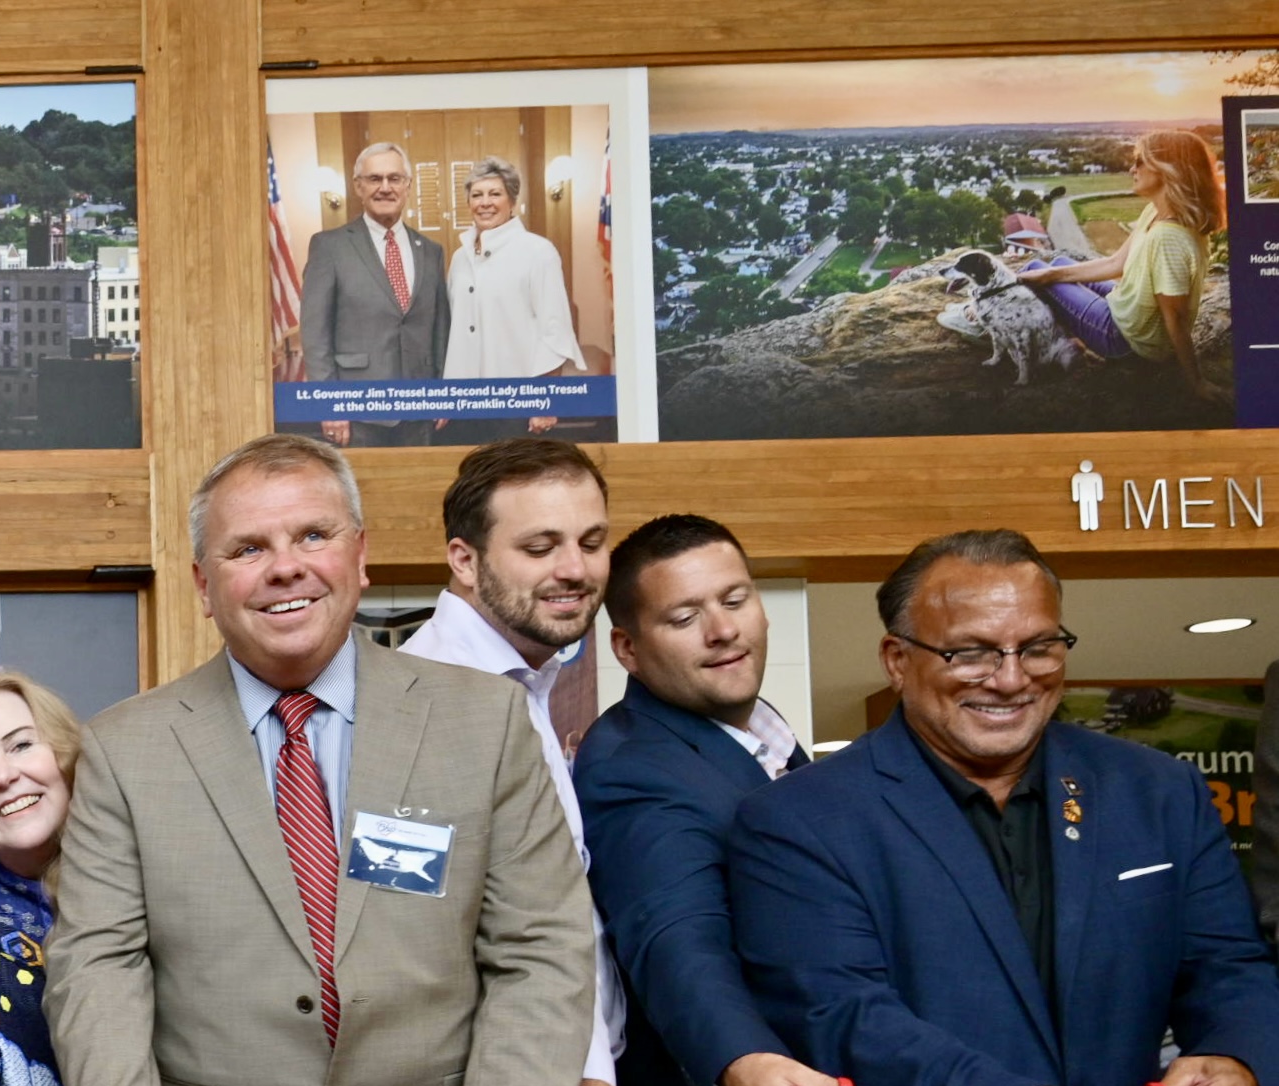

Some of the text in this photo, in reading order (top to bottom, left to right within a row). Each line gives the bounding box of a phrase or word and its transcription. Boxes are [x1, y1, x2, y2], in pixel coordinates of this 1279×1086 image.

[296, 383, 588, 400] Lt. Governor Jim Tressel and Second Lady Ellen Tressel
[333, 397, 551, 412] at the Ohio Statehouse (Franklin County)
[1123, 476, 1263, 529] MEN
